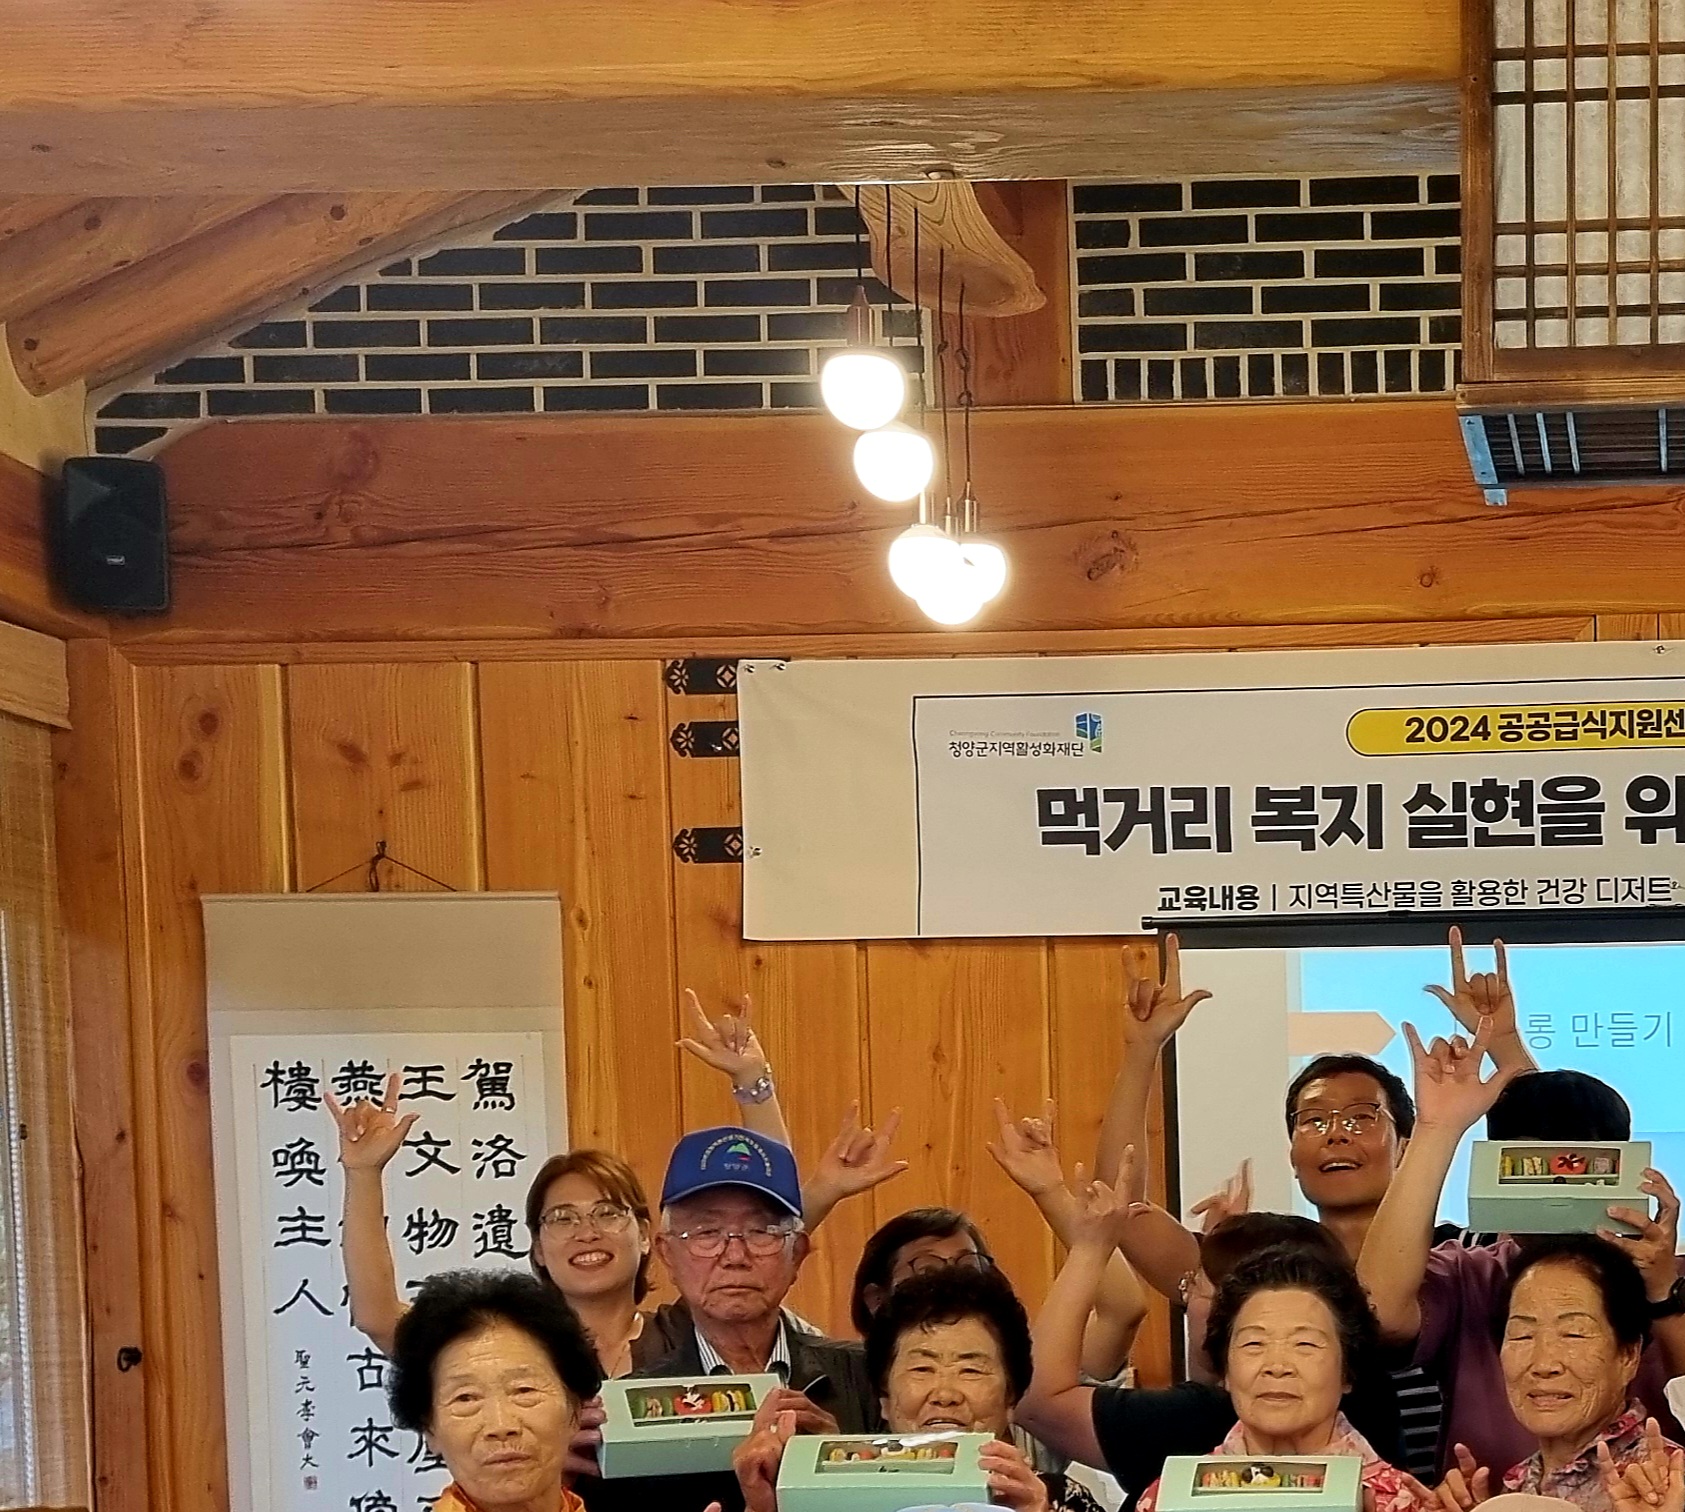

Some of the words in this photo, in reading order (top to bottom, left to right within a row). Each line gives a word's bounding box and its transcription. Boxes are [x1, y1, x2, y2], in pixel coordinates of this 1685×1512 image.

[1406, 715, 1491, 742] 2024
[950, 741, 1083, 757] 청양군지역활성화재단
[1037, 787, 1232, 855] 먹거리
[1251, 784, 1383, 851] 복지
[1403, 776, 1605, 848] 실현을
[1158, 886, 1260, 911] 교육내용
[1290, 881, 1442, 908] 지역특산물을
[1451, 879, 1528, 904] 활용한
[1537, 878, 1587, 904] 건강
[1597, 877, 1672, 903] 디저트
[1572, 1012, 1671, 1048] 만들기
